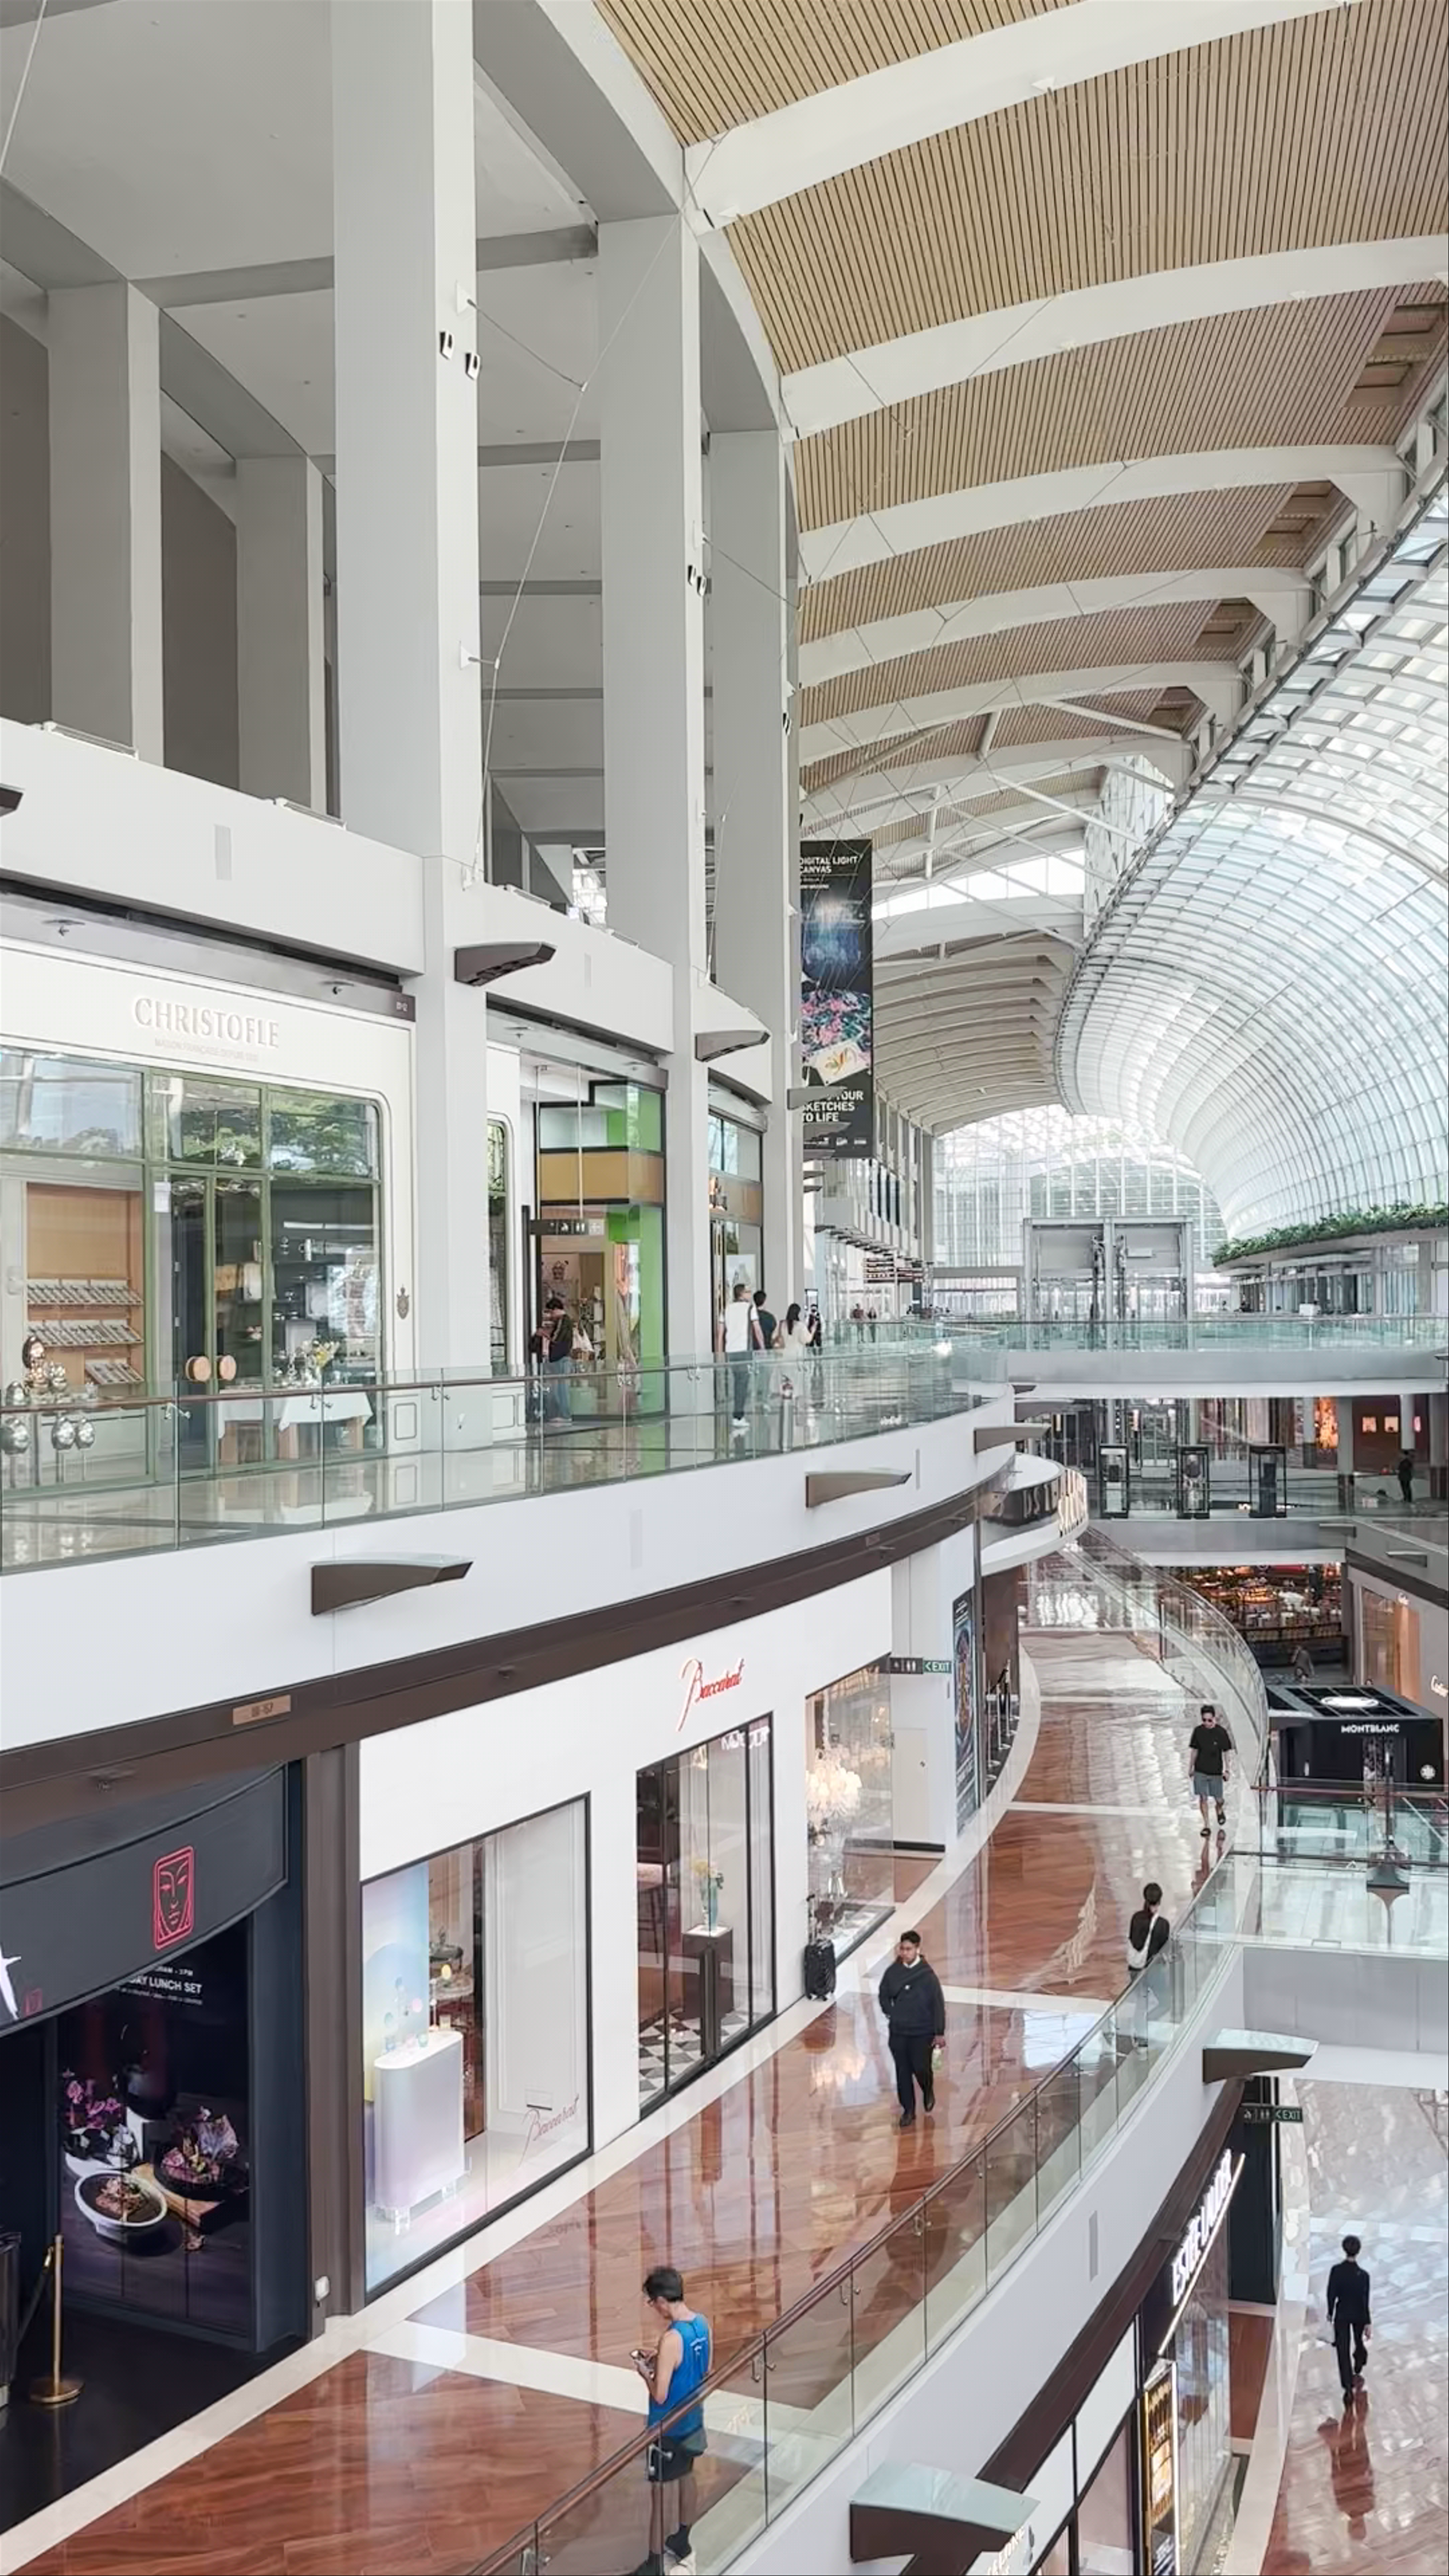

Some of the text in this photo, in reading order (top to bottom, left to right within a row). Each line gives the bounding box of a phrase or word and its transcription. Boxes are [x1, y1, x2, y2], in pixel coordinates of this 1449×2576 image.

[832, 856, 858, 865] LIGHT
[135, 997, 279, 1048] CHRISTOFLE
[815, 1112, 839, 1122] LIFE
[932, 1661, 949, 1672] EXIT
[678, 1658, 745, 1732] Baccarat
[1341, 1723, 1400, 1734] MONTBLANC
[149, 1977, 182, 1991] LUNCH
[183, 1982, 202, 1994] SET
[1283, 2110, 1300, 2120] EXIT
[519, 2093, 580, 2167] Baccarat
